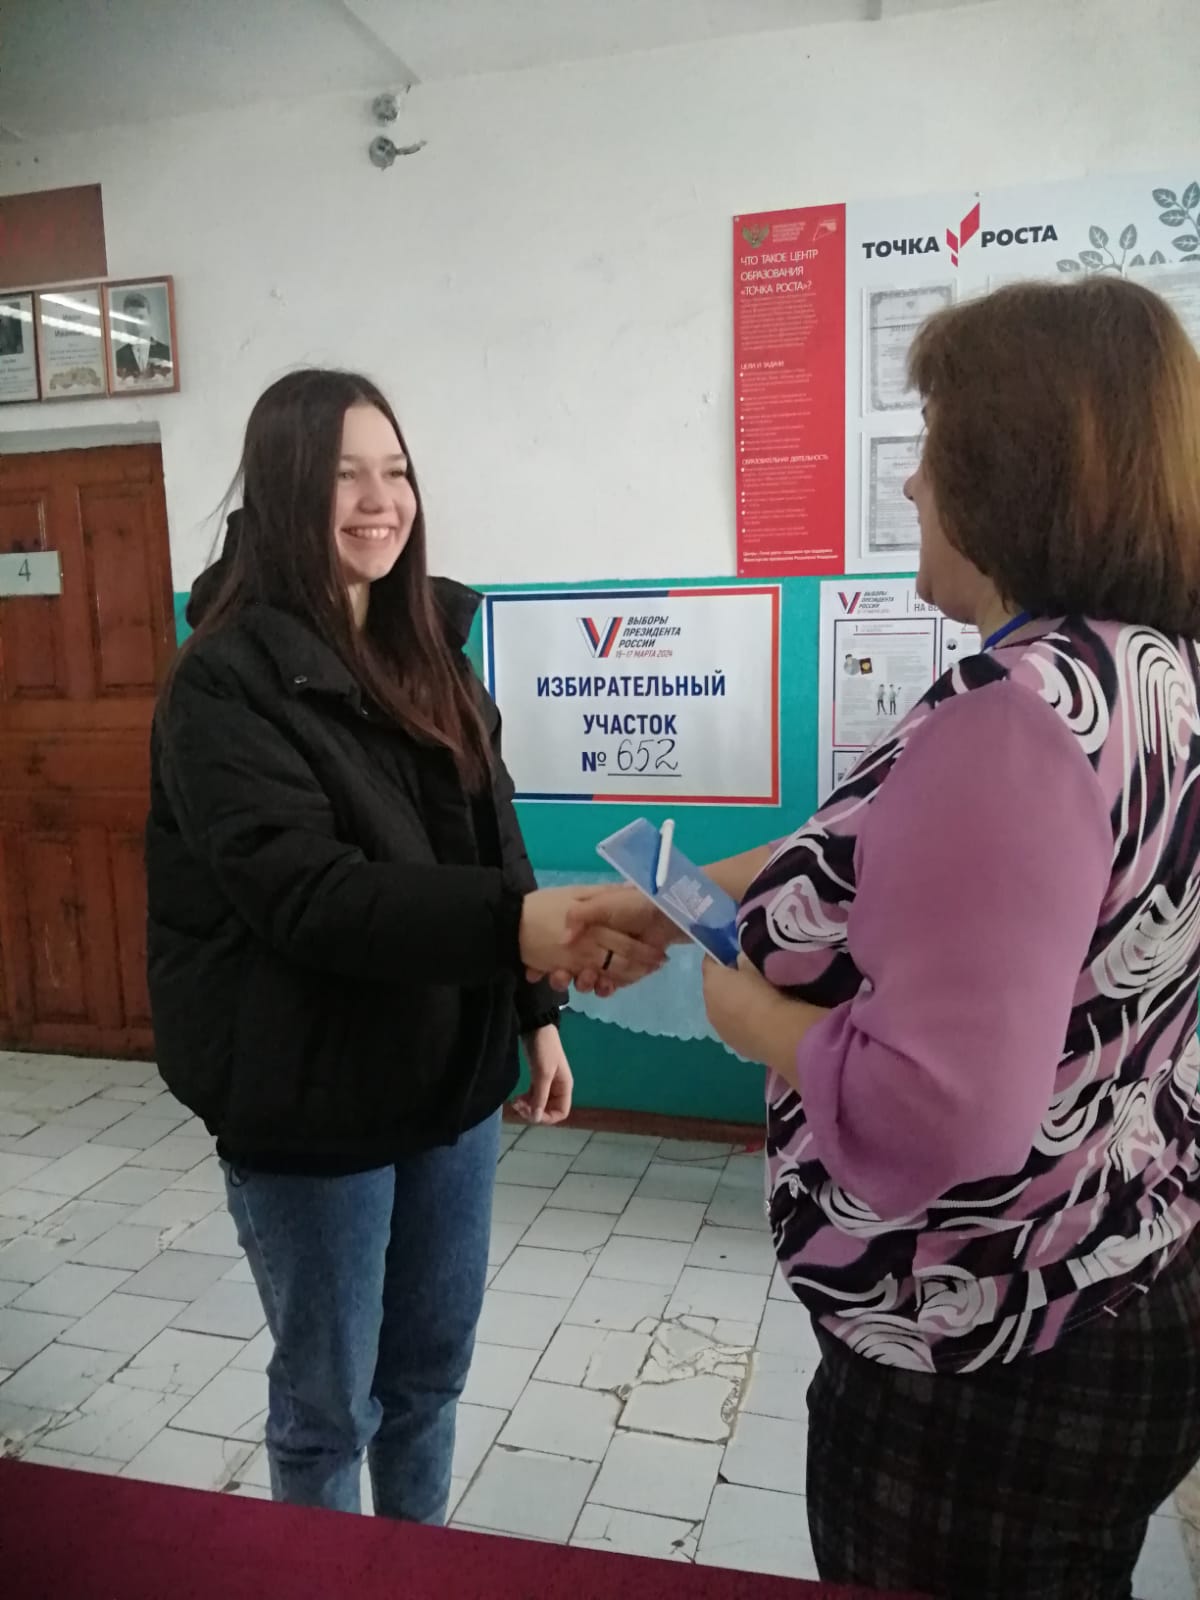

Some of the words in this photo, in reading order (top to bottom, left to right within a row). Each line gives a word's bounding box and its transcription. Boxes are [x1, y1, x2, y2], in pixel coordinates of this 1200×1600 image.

[862, 236, 940, 259] ТОЧКА
[980, 224, 1058, 248] РОСТА
[740, 255, 759, 267] ЧТО
[761, 252, 786, 265] ТАКОЕ
[789, 249, 819, 263] ЦЕНТР
[740, 266, 804, 282] ОБРАЗОВАНИЯ
[18, 558, 32, 583] 4
[914, 603, 926, 612] НА
[627, 616, 669, 626] ВЫБОРЫ
[622, 627, 682, 638] ПРЕЗИДЕНТА
[618, 639, 656, 649] РОССИИ
[634, 650, 656, 658] МАРТА
[536, 669, 726, 697] ИЗБИРАТЕЛЬНЫЙ
[583, 714, 678, 735] УЧАСТОК
[581, 751, 607, 772] №
[617, 738, 679, 772] 652
